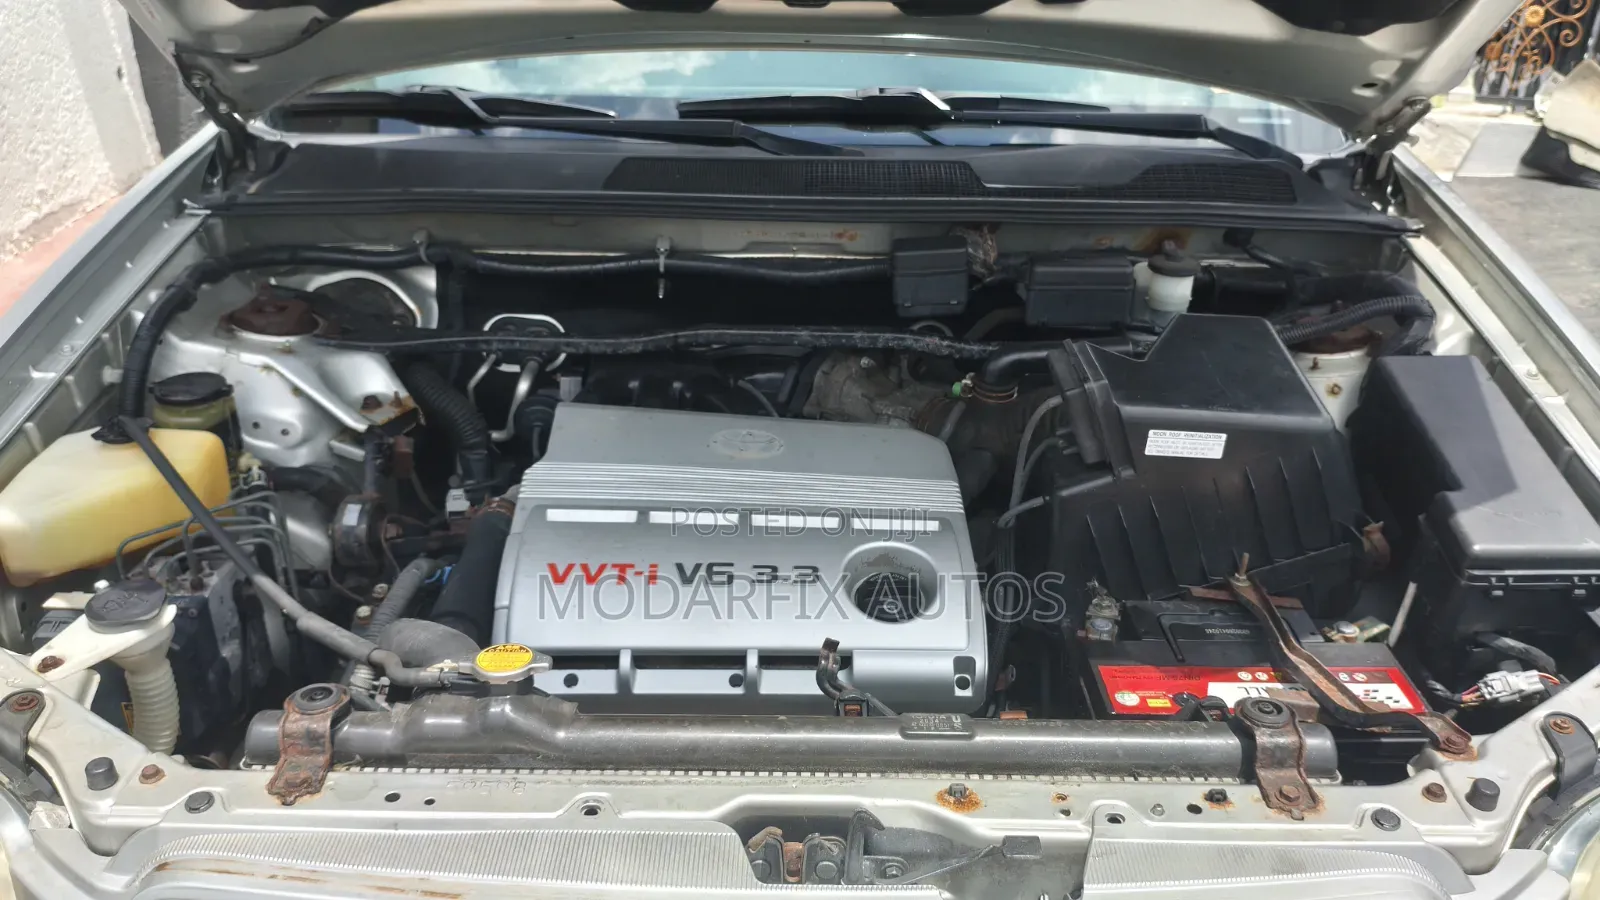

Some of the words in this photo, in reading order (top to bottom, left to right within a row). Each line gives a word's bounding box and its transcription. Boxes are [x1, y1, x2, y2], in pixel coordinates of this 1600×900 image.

[547, 563, 659, 585] VVT-i
[675, 563, 735, 585] V6
[752, 565, 820, 586] 3.3
